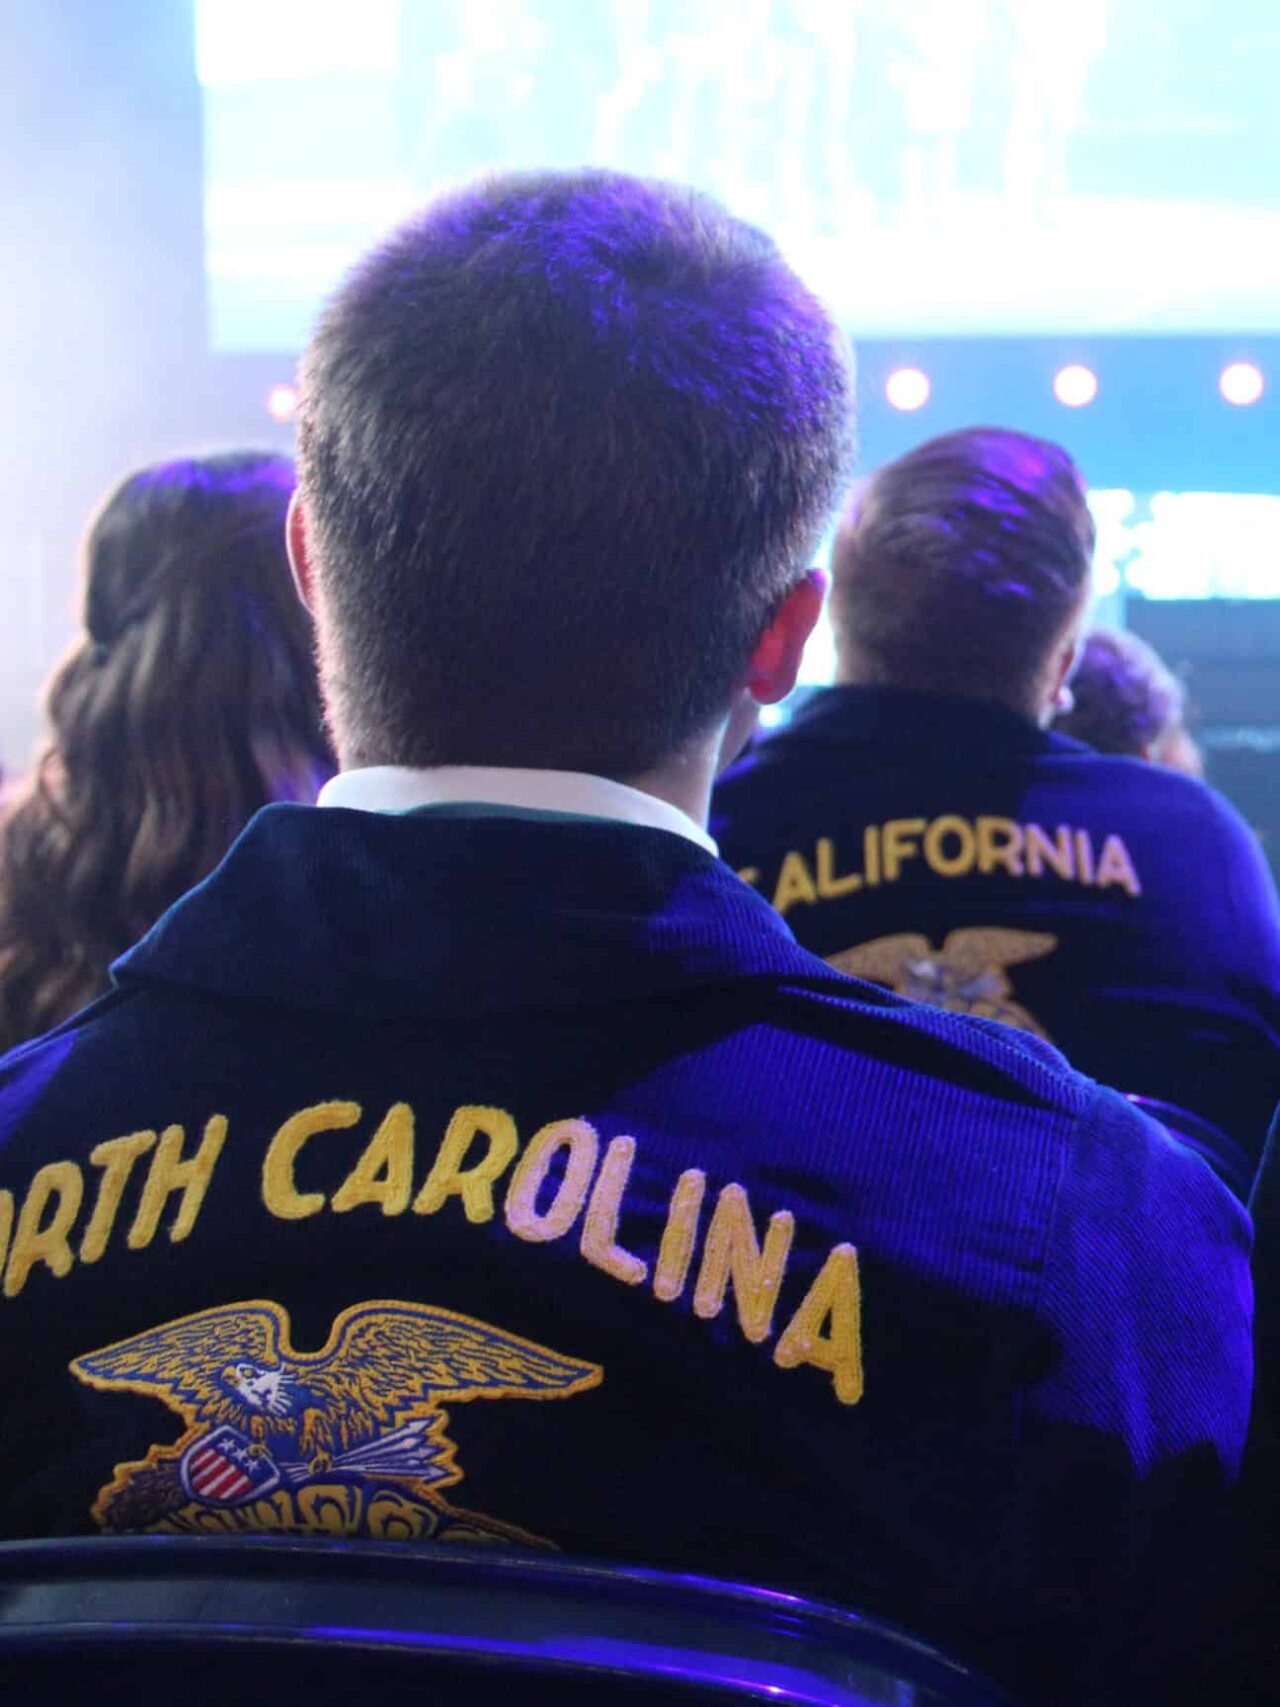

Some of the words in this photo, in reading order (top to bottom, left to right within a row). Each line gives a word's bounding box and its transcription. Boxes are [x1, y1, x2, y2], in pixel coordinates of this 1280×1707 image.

[735, 814, 1142, 914] ALIFORNIA
[0, 1113, 229, 1297] RTH
[262, 1100, 865, 1405] CAROLINA
